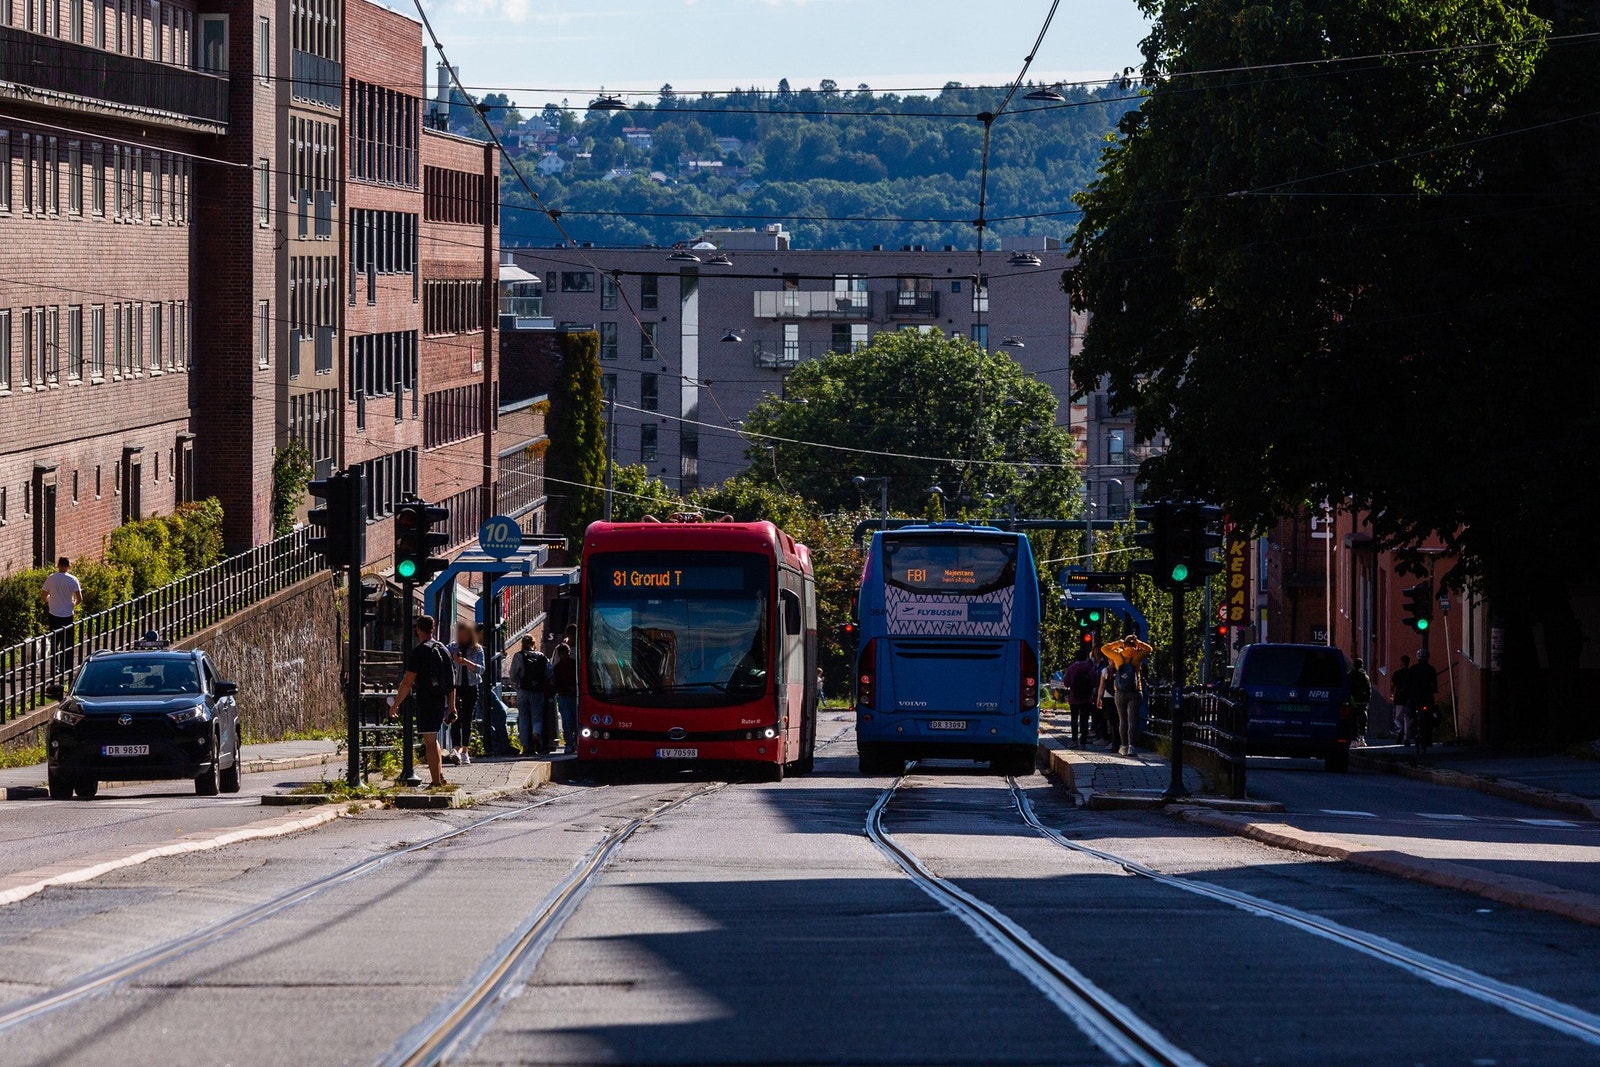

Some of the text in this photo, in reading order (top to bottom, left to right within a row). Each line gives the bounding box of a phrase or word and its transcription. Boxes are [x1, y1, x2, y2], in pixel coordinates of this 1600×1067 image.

[485, 523, 509, 543] 10
[613, 570, 682, 587] 31 Grorud T
[907, 569, 926, 582] FB1
[1230, 540, 1246, 621] KEBAB
[1309, 690, 1330, 698] NPM
[108, 746, 147, 755] DR 98517
